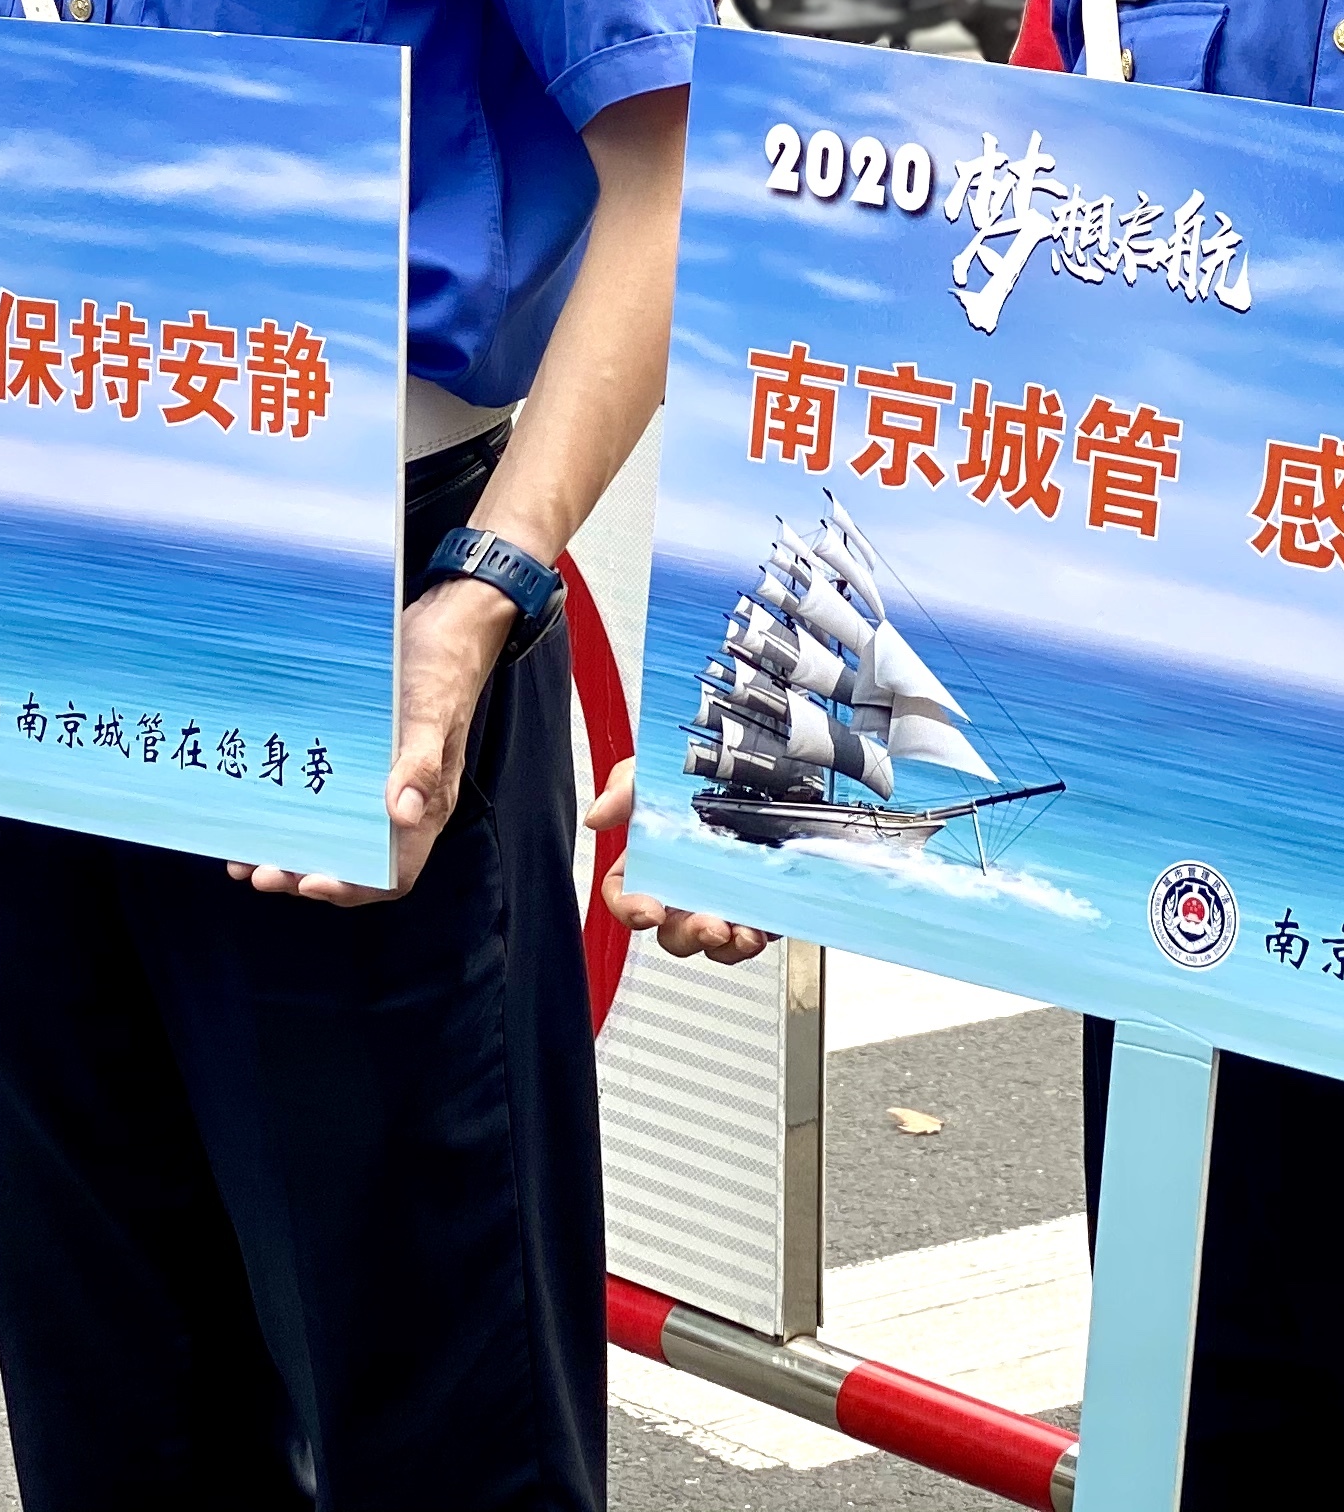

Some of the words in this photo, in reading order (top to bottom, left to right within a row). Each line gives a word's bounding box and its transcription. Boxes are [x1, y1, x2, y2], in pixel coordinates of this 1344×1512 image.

[764, 123, 934, 213] 2020
[745, 341, 1184, 542] 南京城管
[16, 691, 335, 796] 南京城管在您身旁
